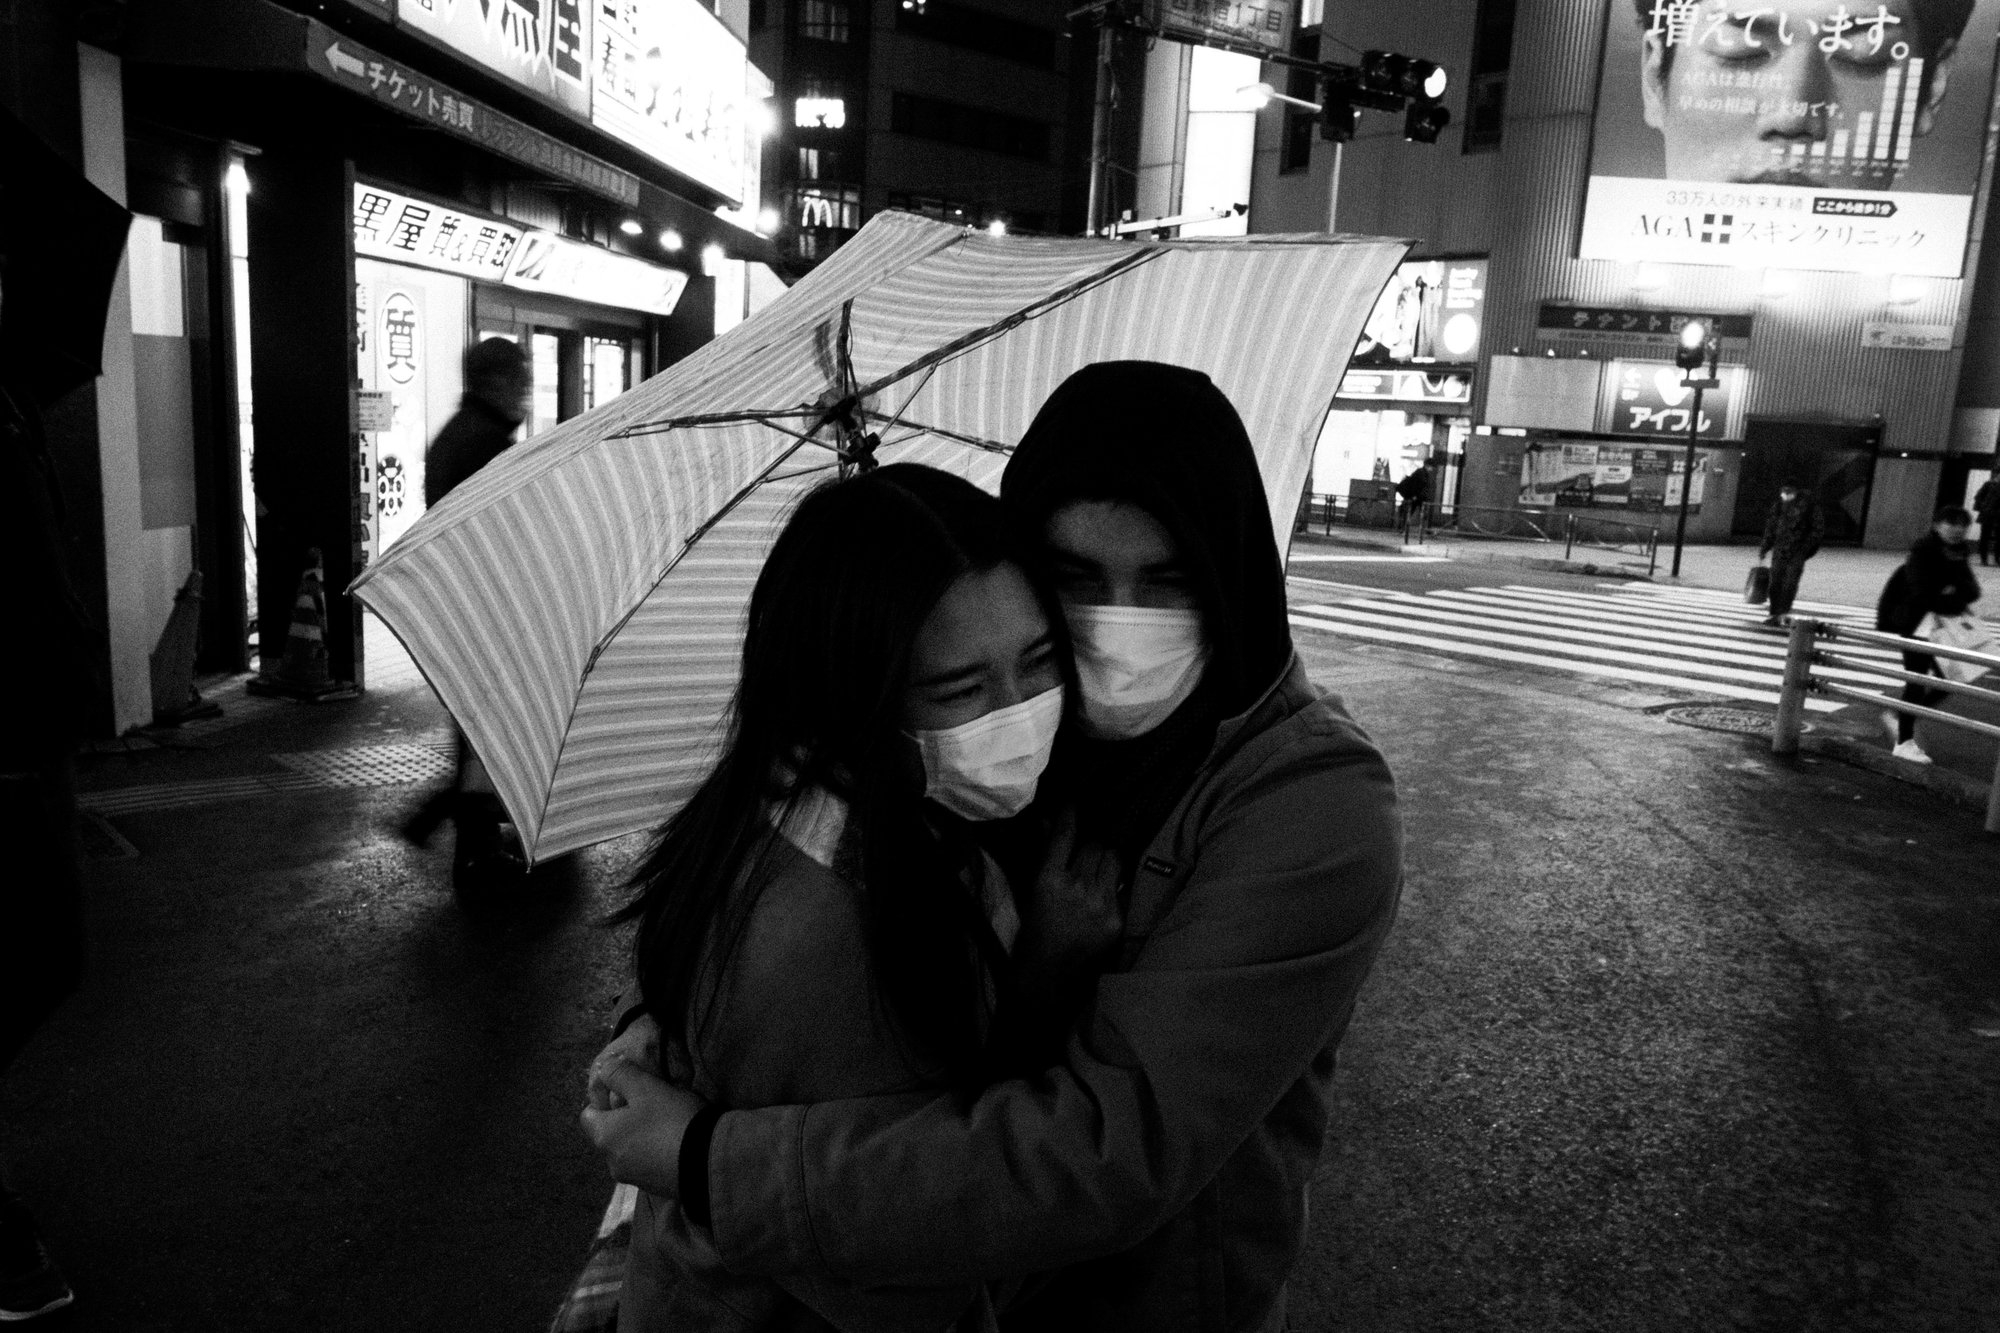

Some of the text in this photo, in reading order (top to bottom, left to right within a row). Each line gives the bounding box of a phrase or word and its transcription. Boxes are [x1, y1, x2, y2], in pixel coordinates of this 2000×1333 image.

[1649, 0, 1910, 60] 増えています。
[367, 61, 475, 133] チケット売買
[1632, 213, 1926, 248] AGA スキンクリニック
[385, 308, 416, 370] 質
[1629, 406, 1711, 433] アイフル
